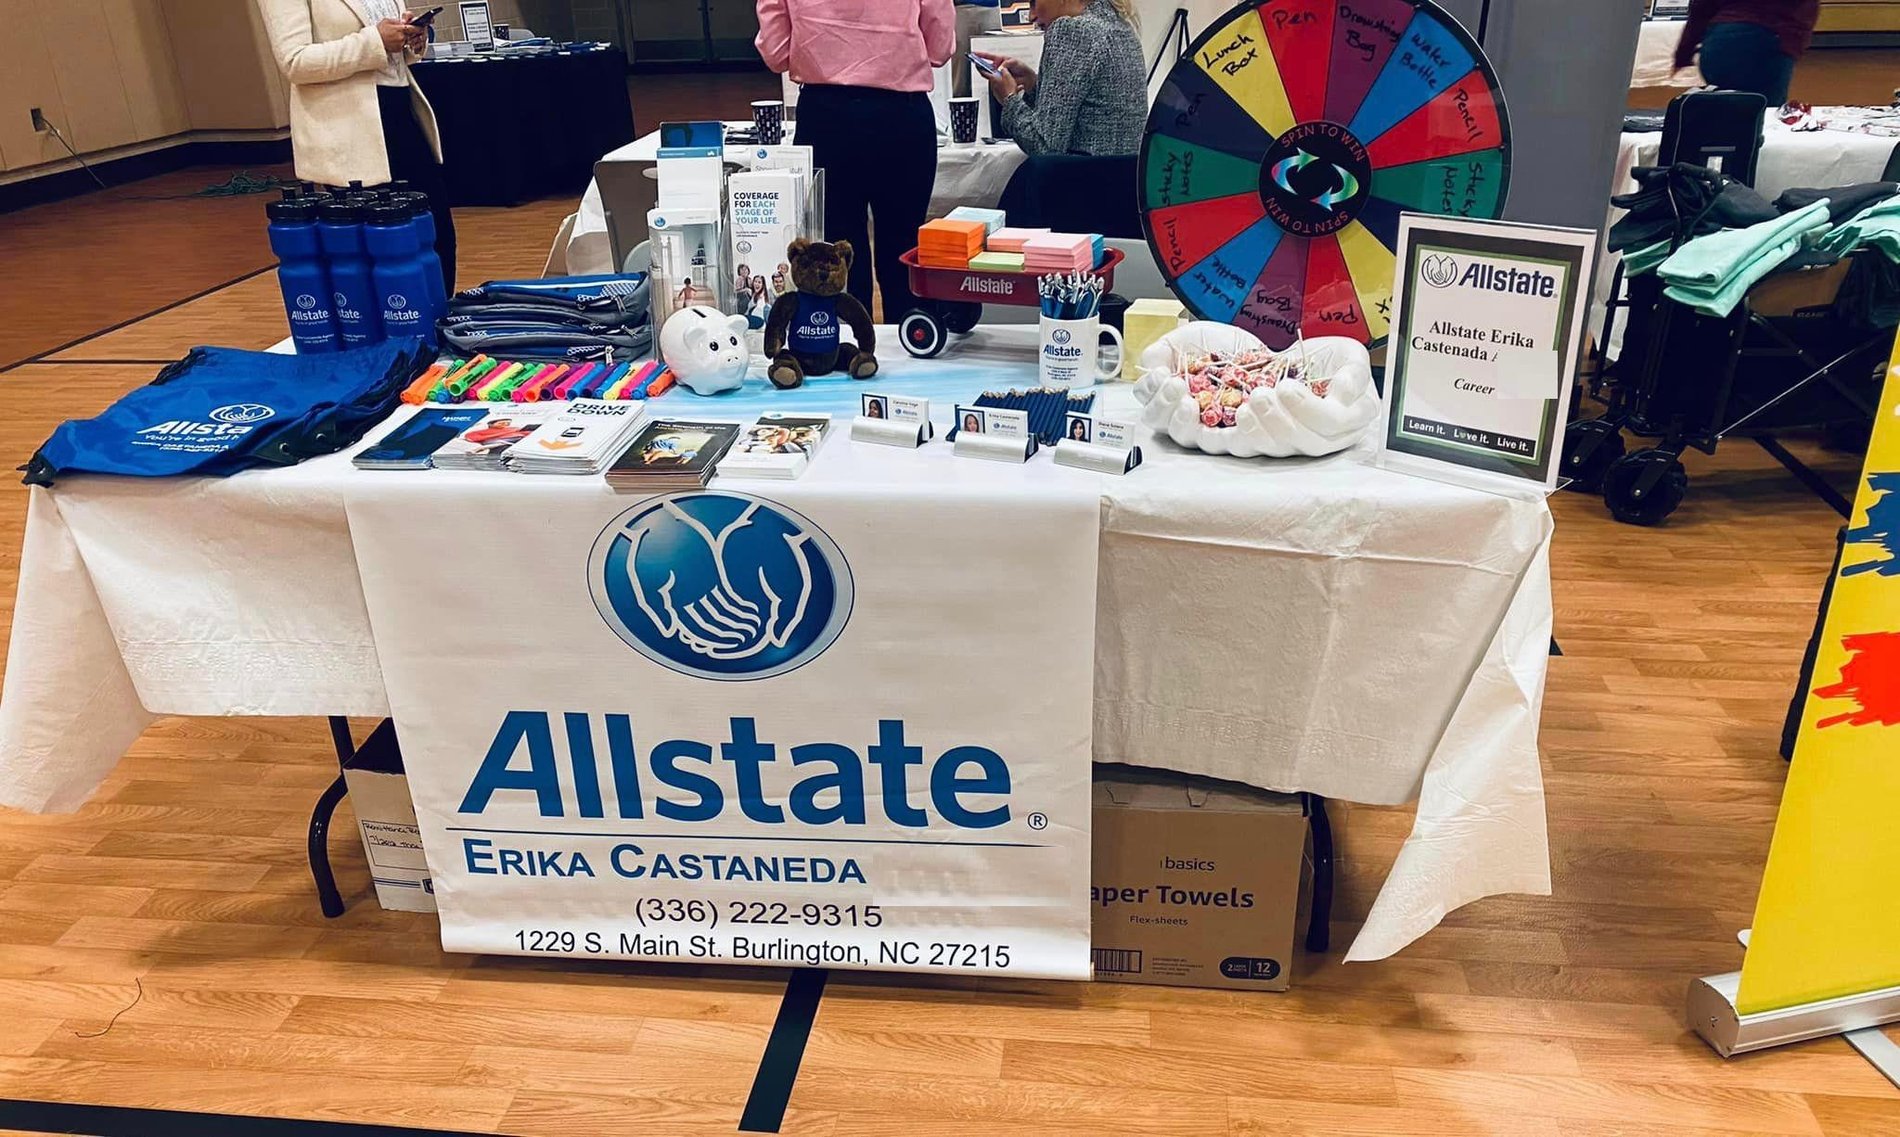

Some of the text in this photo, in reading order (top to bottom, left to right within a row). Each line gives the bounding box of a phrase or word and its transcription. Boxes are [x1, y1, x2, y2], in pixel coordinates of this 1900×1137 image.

[1272, 10, 1317, 30] Pen
[1340, 5, 1401, 43] Drawstring
[1202, 34, 1254, 70] Lunch
[1346, 30, 1376, 62] Bag
[1222, 48, 1258, 76] Box
[1401, 52, 1437, 89] Bottle
[1176, 93, 1206, 127] Pen
[1453, 88, 1483, 142] Pencil
[1282, 124, 1365, 162] SPIN TO WIN
[734, 192, 778, 200] COVERAGE
[734, 200, 776, 208] FOR EACH
[1266, 197, 1348, 234] SPIN TO WIN
[1163, 217, 1185, 272] Pencil
[960, 276, 1014, 295] Allstate
[1459, 262, 1554, 298] Allstate
[1256, 290, 1292, 312] Bag
[292, 310, 329, 320] Allstate
[384, 310, 420, 320] Allstate
[1318, 304, 1358, 324] Pen
[797, 325, 836, 336] Allstate
[1430, 321, 1534, 348] Allstate Erika
[1043, 344, 1081, 356] Allstate
[1412, 336, 1488, 362] Castenada
[1454, 378, 1495, 395] Career
[567, 408, 628, 416] DOWN
[572, 402, 632, 411] DRIVE
[136, 421, 254, 435] Allsta
[1409, 420, 1434, 434] Learn
[1436, 424, 1446, 436] it.
[1480, 432, 1490, 444] it.
[1498, 438, 1518, 450] Live
[1519, 441, 1529, 452] it.
[458, 710, 1012, 829] Allstate
[463, 838, 867, 884] ERIKA CASTANEDA
[1165, 856, 1215, 872] basics
[1091, 885, 1254, 908] aper Towels
[636, 898, 882, 929] (336) 222-9315
[1129, 915, 1188, 926] Flex-sheets
[516, 930, 1010, 968] 1229 S. Main St. Burlington, NC 27215
[1228, 964, 1234, 972] 2
[1256, 962, 1271, 974] 12
